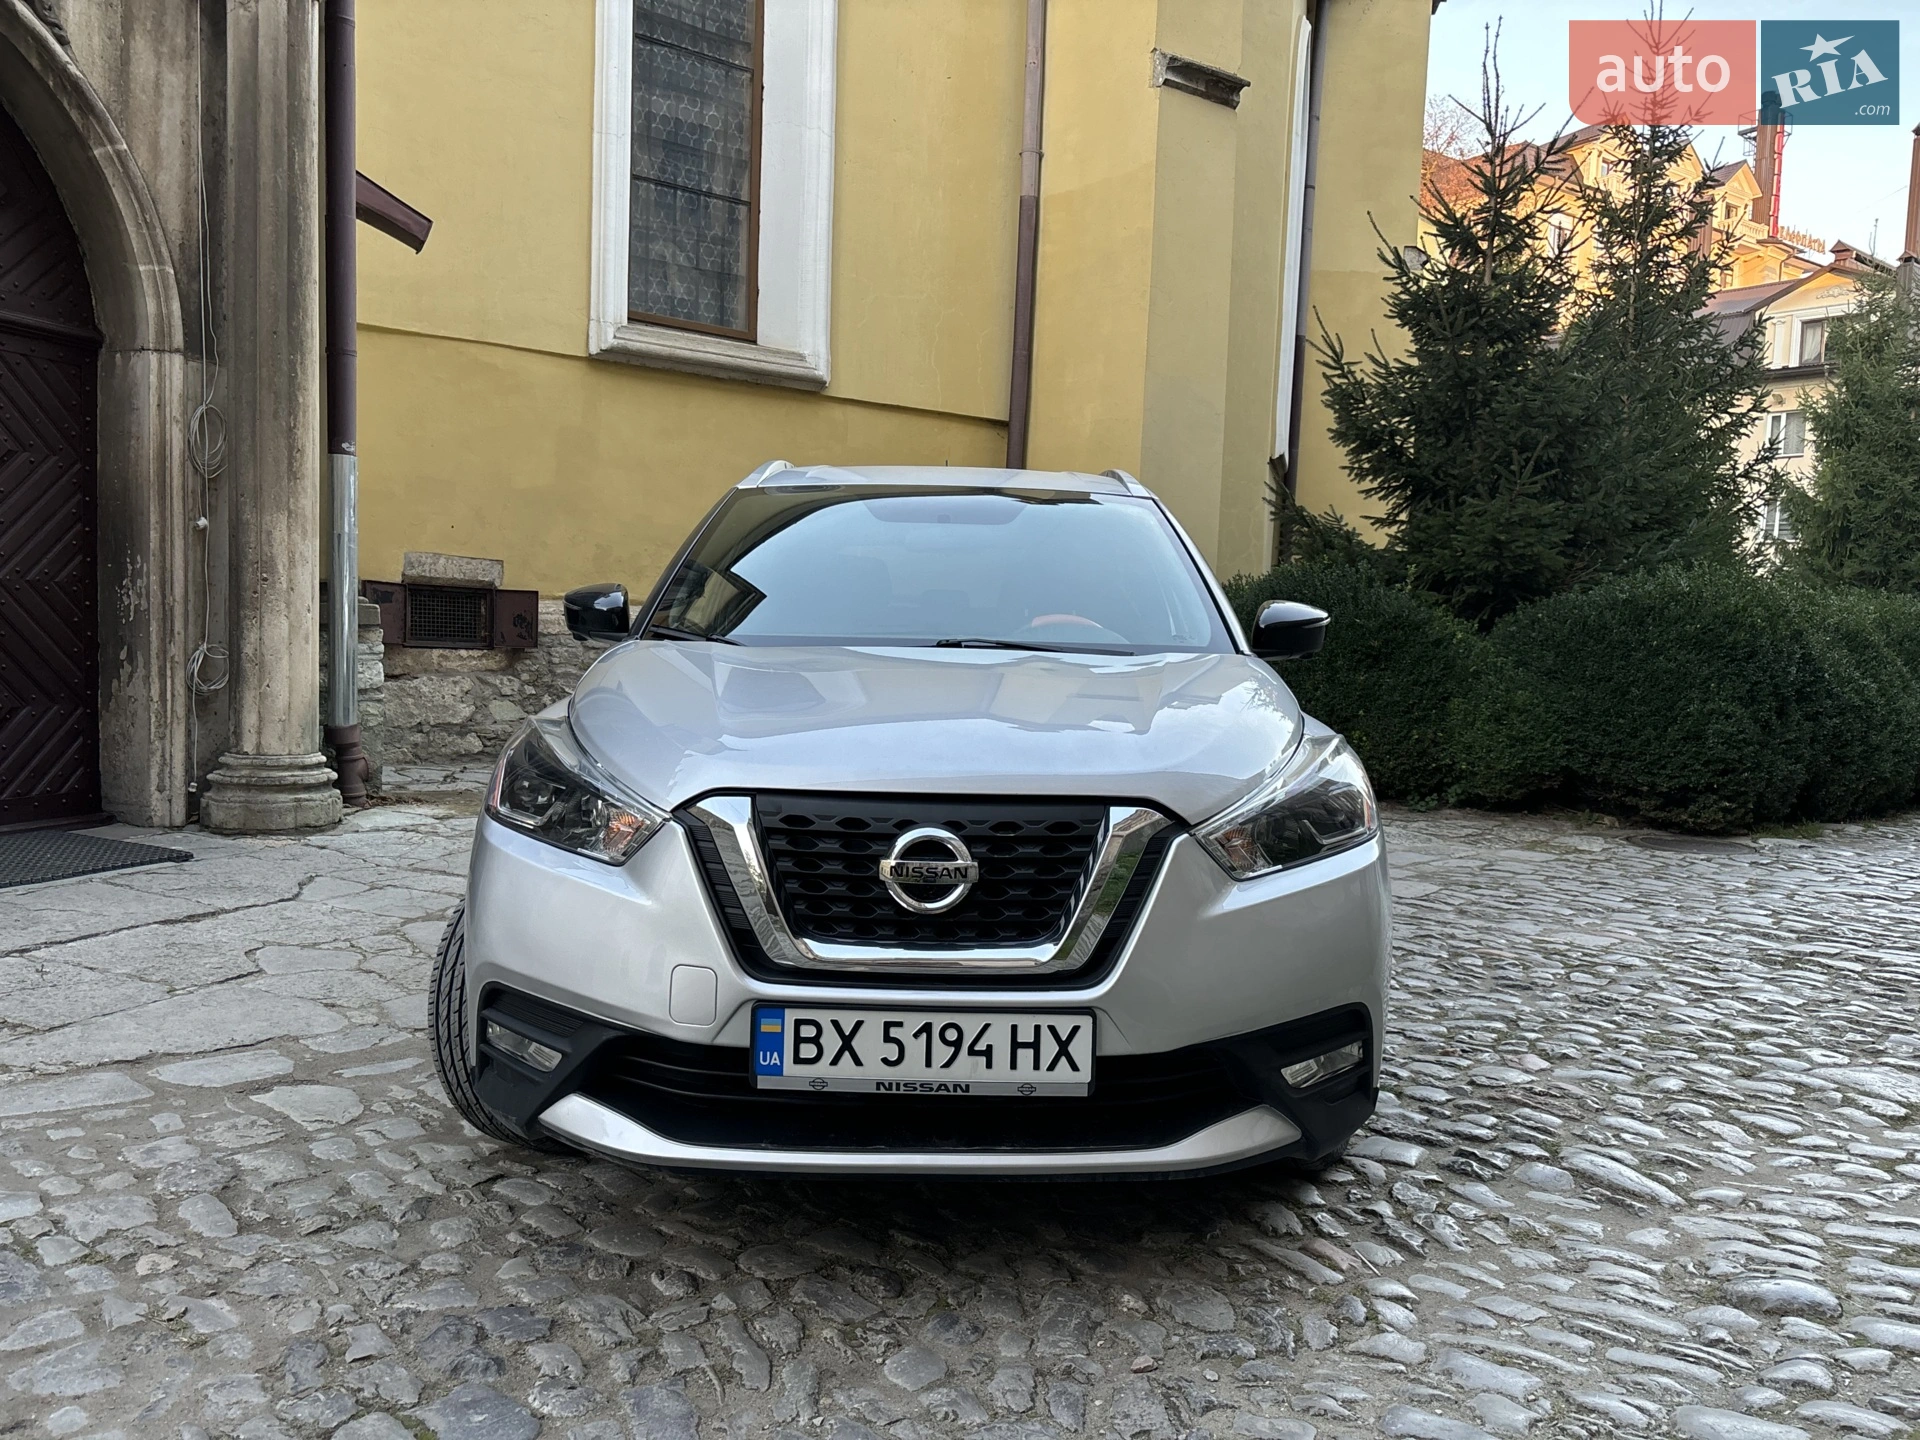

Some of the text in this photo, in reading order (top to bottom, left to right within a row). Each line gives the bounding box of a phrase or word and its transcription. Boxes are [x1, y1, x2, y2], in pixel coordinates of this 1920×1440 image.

[889, 865, 968, 879] NISSAN
[792, 1018, 1081, 1072] BX 5194 HX
[759, 1051, 781, 1066] UA
[875, 1080, 971, 1094] NISSAN
